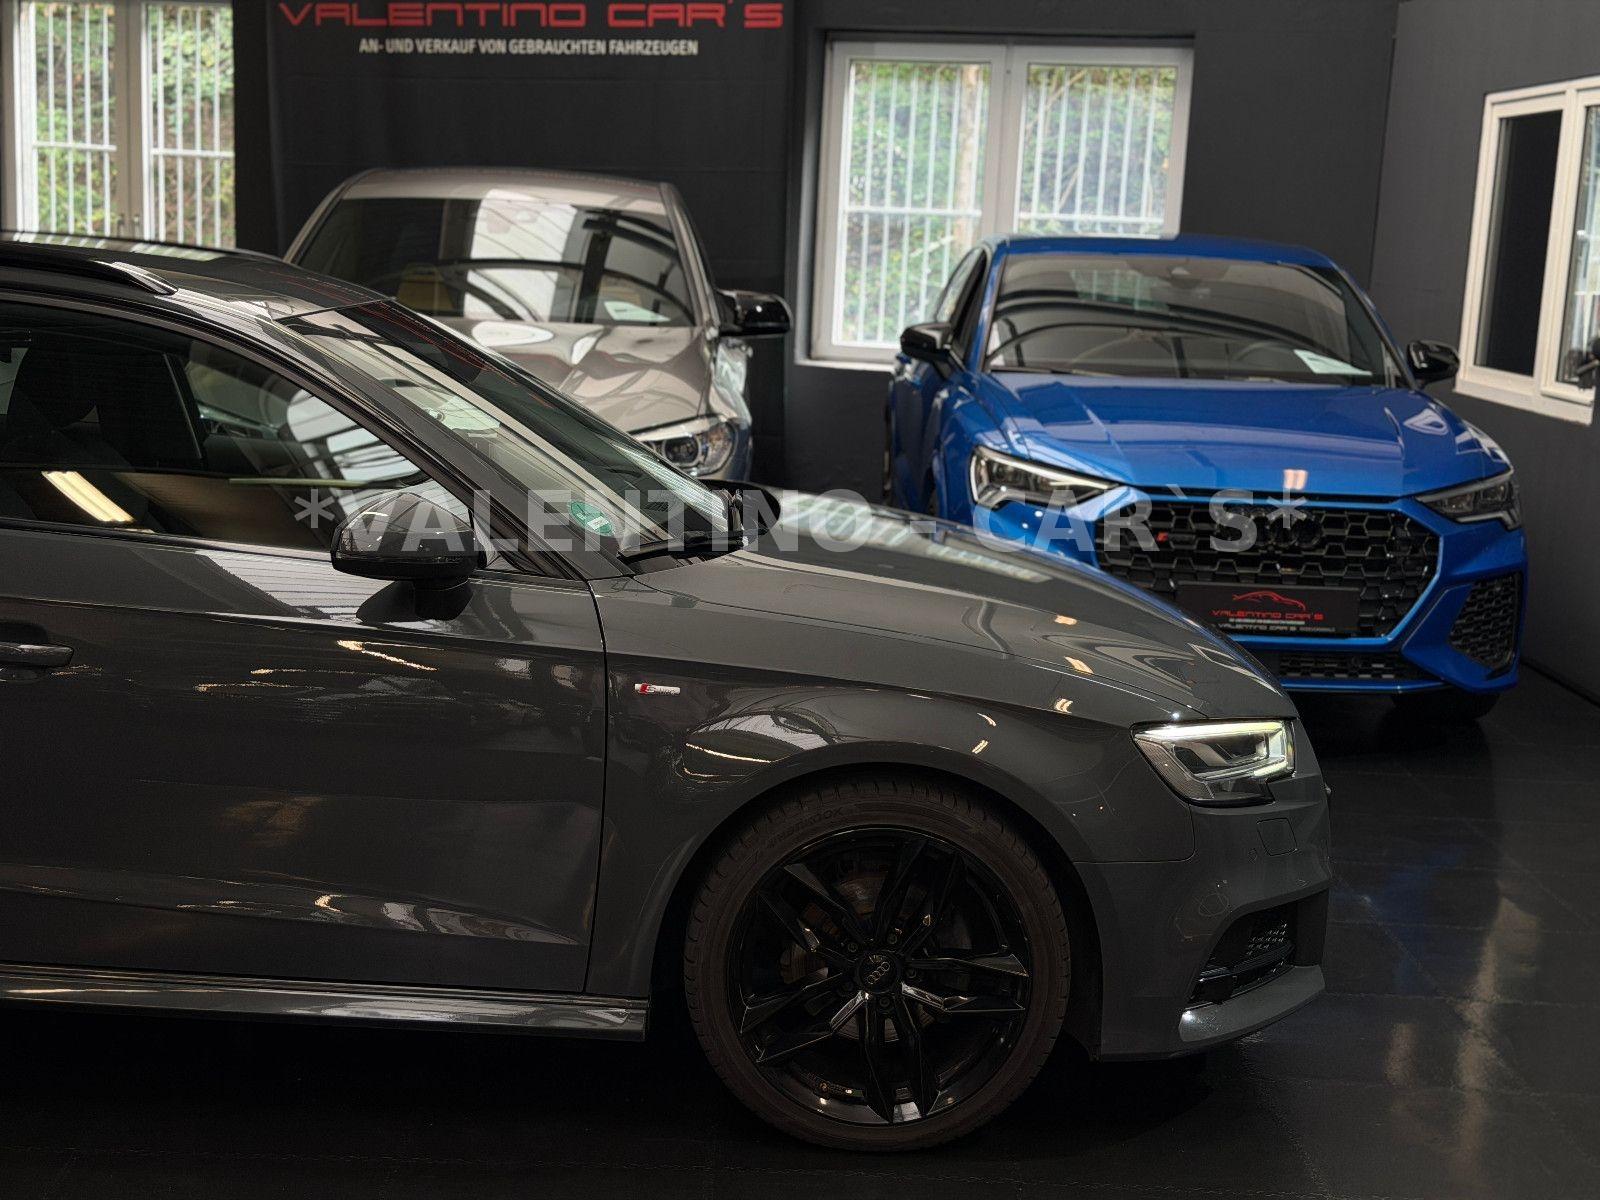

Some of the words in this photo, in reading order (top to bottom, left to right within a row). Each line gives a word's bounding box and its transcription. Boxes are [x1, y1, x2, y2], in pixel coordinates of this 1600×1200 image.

[278, 2, 586, 27] VALENTINO
[359, 38, 384, 53] AN-
[385, 38, 414, 54] UND
[415, 38, 477, 54] VERKAUF
[478, 38, 507, 54] VON
[508, 38, 607, 55] GEBRAUCHTEN
[608, 39, 699, 56] FAHRZEUGEN
